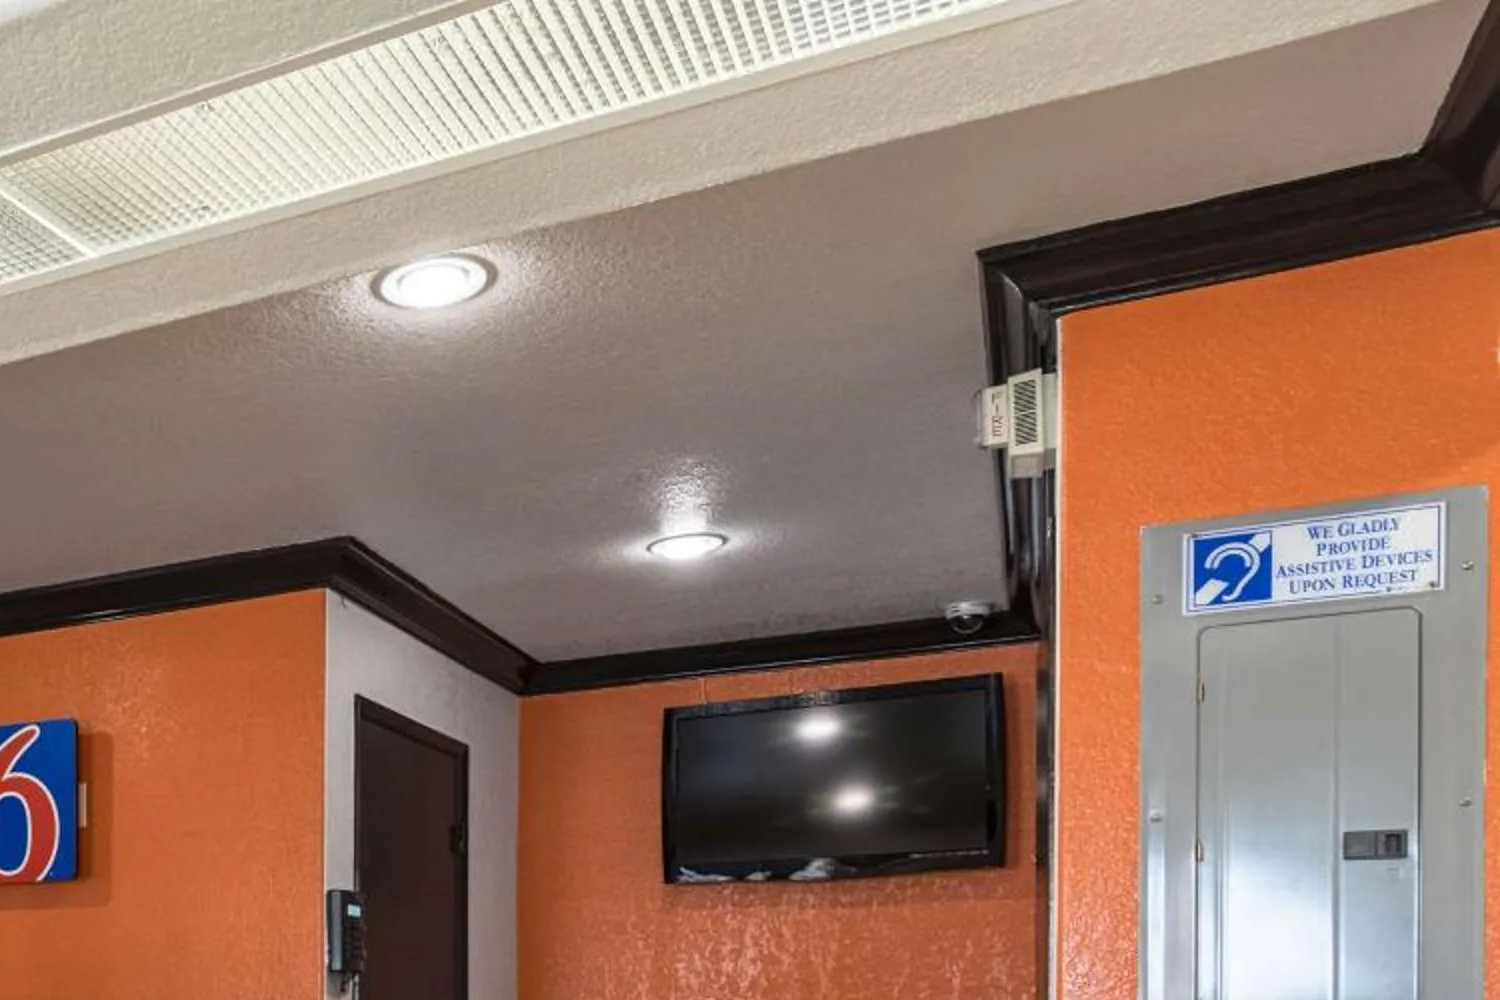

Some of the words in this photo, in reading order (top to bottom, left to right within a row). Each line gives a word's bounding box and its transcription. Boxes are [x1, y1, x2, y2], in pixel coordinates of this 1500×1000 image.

[1307, 525, 1333, 540] WE
[1338, 516, 1401, 537] GLADLY
[1316, 537, 1391, 557] PROVIDE
[1276, 558, 1355, 578] ASSISTIVE
[1362, 551, 1433, 569] DEVICES
[1289, 578, 1336, 594] UPON
[1342, 570, 1418, 589] REQUEST
